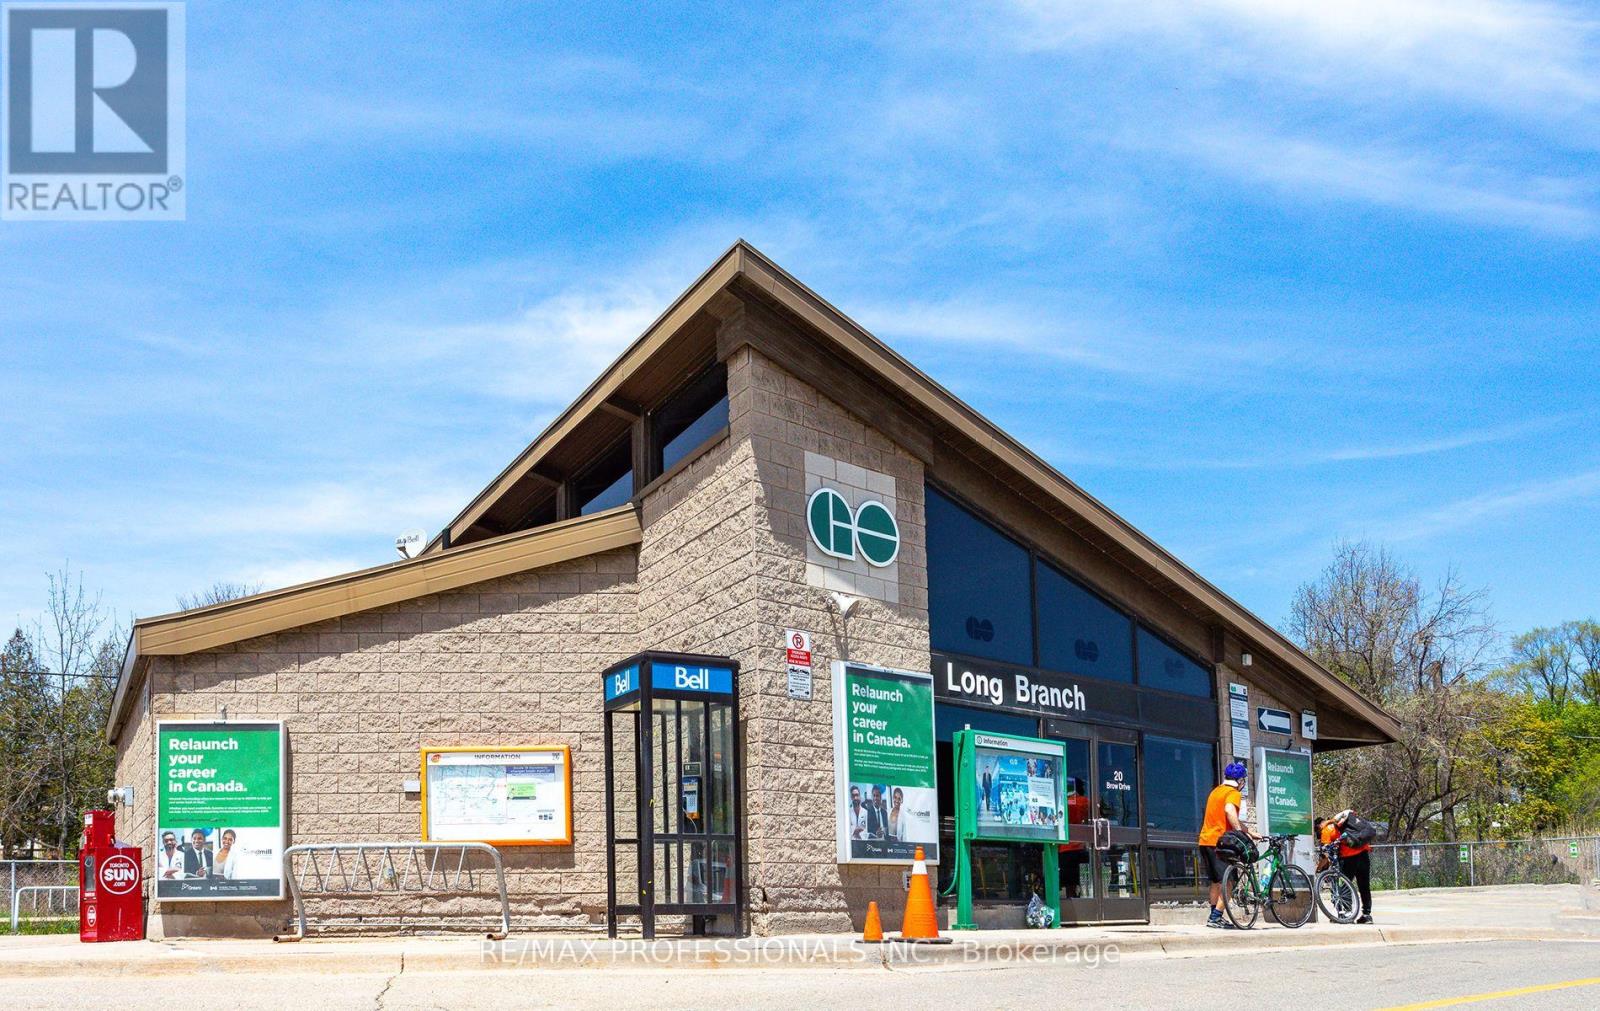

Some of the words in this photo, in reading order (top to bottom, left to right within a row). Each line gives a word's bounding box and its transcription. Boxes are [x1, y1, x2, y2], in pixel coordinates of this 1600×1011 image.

[615, 670, 630, 695] Bell
[675, 666, 710, 690] Bell
[852, 683, 903, 702] Relaunch
[947, 662, 1003, 705] Long
[1015, 674, 1086, 711] Branch
[852, 701, 877, 715] your
[852, 717, 887, 731] career
[169, 738, 238, 750] Relaunch
[853, 730, 864, 743] in
[866, 732, 911, 748] Canada.
[983, 738, 1008, 747] Information
[169, 755, 203, 766] your
[169, 768, 217, 778] career
[1267, 761, 1294, 774] Relaunch
[1113, 770, 1123, 781] 20
[1268, 774, 1281, 785] your
[168, 781, 182, 792] in
[186, 780, 248, 792] Canada.
[1119, 783, 1131, 791] Drive
[1268, 785, 1286, 795] career
[1269, 796, 1275, 805] in
[104, 869, 134, 881] SUN
